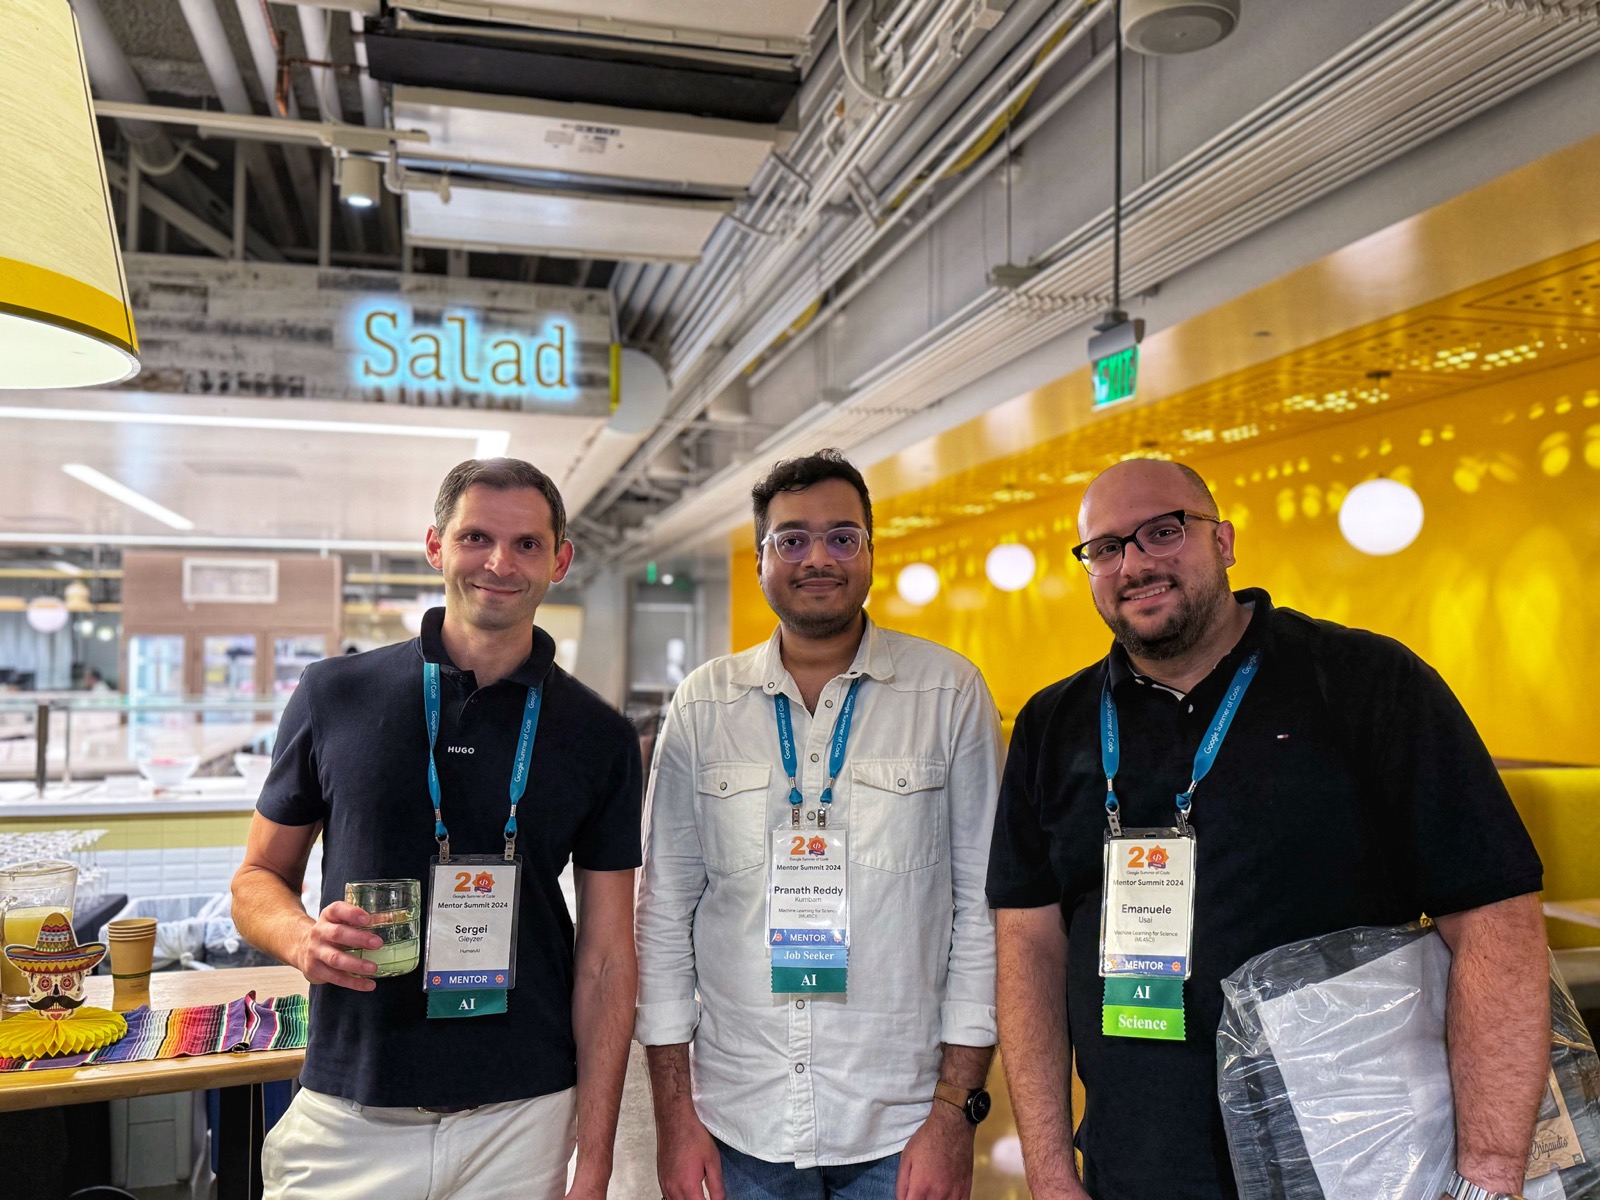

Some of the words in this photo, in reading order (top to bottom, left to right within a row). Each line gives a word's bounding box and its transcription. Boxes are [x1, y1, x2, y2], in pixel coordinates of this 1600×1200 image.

[363, 310, 569, 390] Salad
[1229, 685, 1242, 701] Code
[1227, 700, 1233, 708] of
[840, 715, 848, 735] Summer
[1214, 708, 1230, 732] Summer
[524, 719, 532, 734] Code
[1204, 731, 1219, 754] Google
[447, 746, 475, 755] HUGO
[518, 740, 528, 762] Summer
[834, 742, 842, 758] Code
[514, 762, 525, 783] Google
[774, 886, 811, 895] Pranath
[813, 886, 844, 897] Reddy
[1121, 904, 1172, 915] Emanuele
[1138, 916, 1153, 924] Usai
[455, 924, 488, 935] Sergei
[789, 934, 826, 942] MENTOR
[783, 950, 801, 960] Job
[803, 950, 835, 960] Seeker
[1124, 960, 1164, 970] MENTOR
[449, 975, 488, 984] MENTOR
[801, 974, 817, 986] AI
[1133, 985, 1151, 999] AI
[458, 998, 475, 1010] AI
[1118, 1013, 1168, 1030] Science
